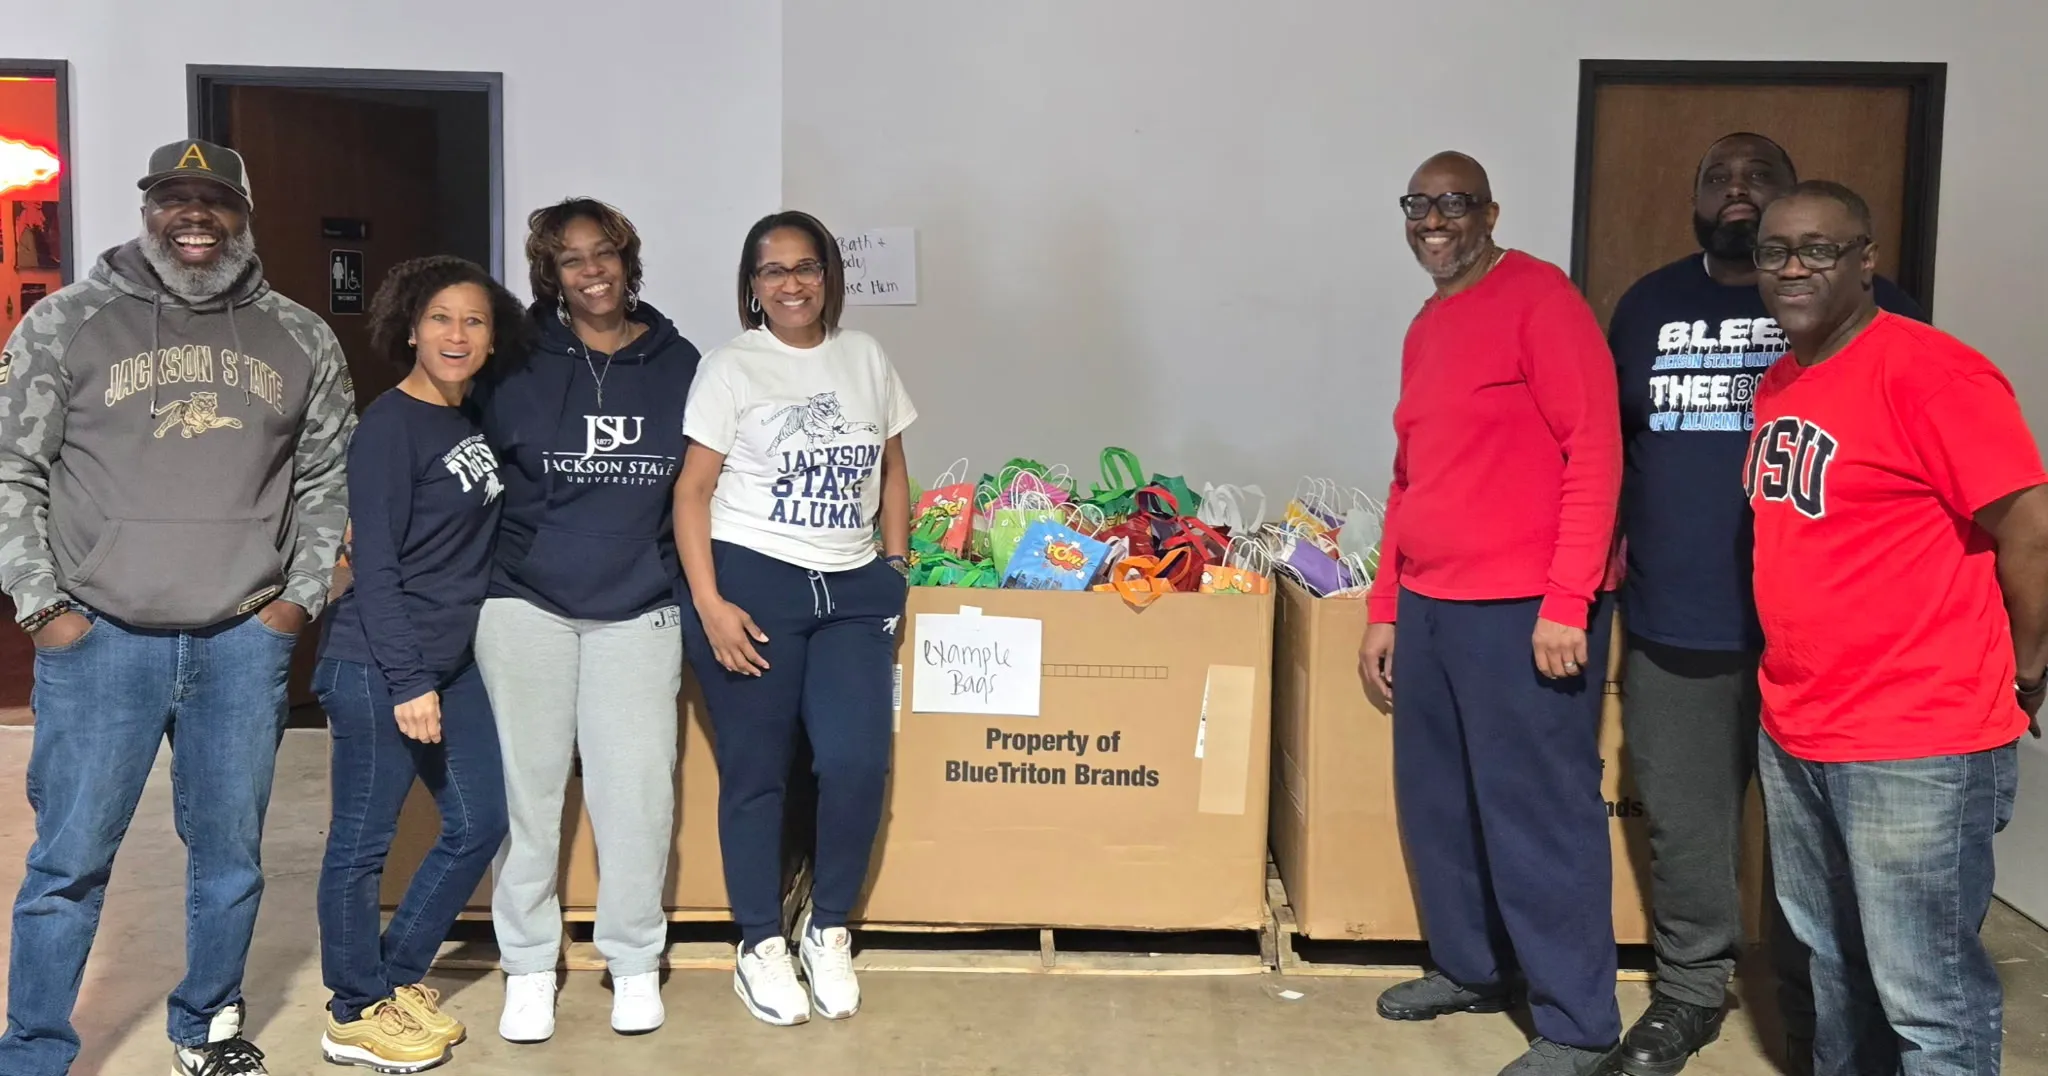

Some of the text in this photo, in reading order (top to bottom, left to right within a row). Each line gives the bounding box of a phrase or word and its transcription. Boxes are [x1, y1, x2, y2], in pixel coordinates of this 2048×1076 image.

[173, 143, 212, 171] A
[836, 234, 872, 253] Bath
[842, 254, 866, 279] ody
[1657, 317, 1791, 354] BLEE
[1652, 352, 1783, 370] JACKSON STATE UNIV
[105, 344, 214, 407] JACKSON
[1680, 411, 1742, 431] ALUMNI
[583, 415, 645, 460] JSU
[543, 459, 675, 476] JACKSON STATE
[778, 444, 881, 474] JACKSON
[1743, 416, 1838, 519] JSU
[567, 475, 656, 486] UNIVERSITY
[771, 464, 873, 500] STATE
[947, 669, 998, 704] Bags
[986, 727, 1121, 756] Property of
[945, 760, 1160, 787] BlueTriton Brands
